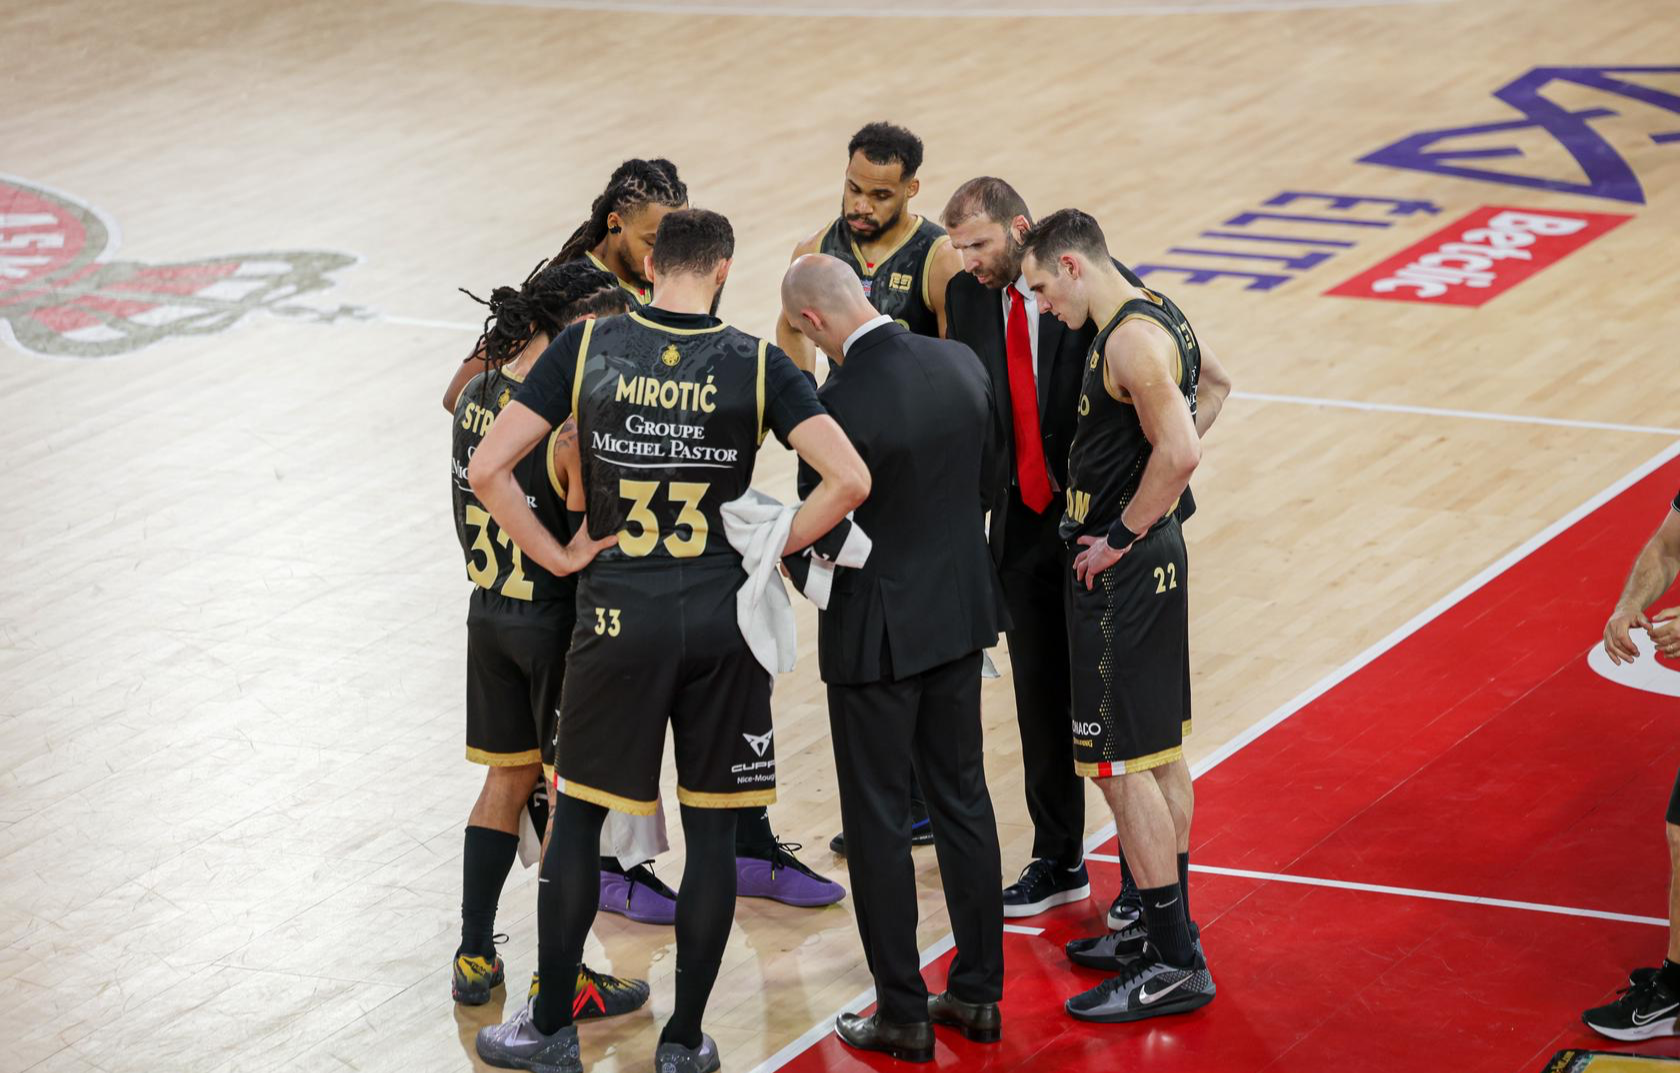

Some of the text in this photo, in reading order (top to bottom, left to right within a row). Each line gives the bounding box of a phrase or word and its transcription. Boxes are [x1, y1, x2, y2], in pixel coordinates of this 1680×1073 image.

[1372, 209, 1589, 299] Betclic
[615, 375, 718, 413] MIROTIĆ
[461, 402, 495, 437] STR
[625, 415, 705, 440] GROUPE
[591, 430, 738, 463] MICHEL PASTOR
[617, 479, 711, 558] 33
[1153, 562, 1178, 595] 22
[594, 607, 622, 638] 33
[736, 774, 776, 785] Nice-Moug
